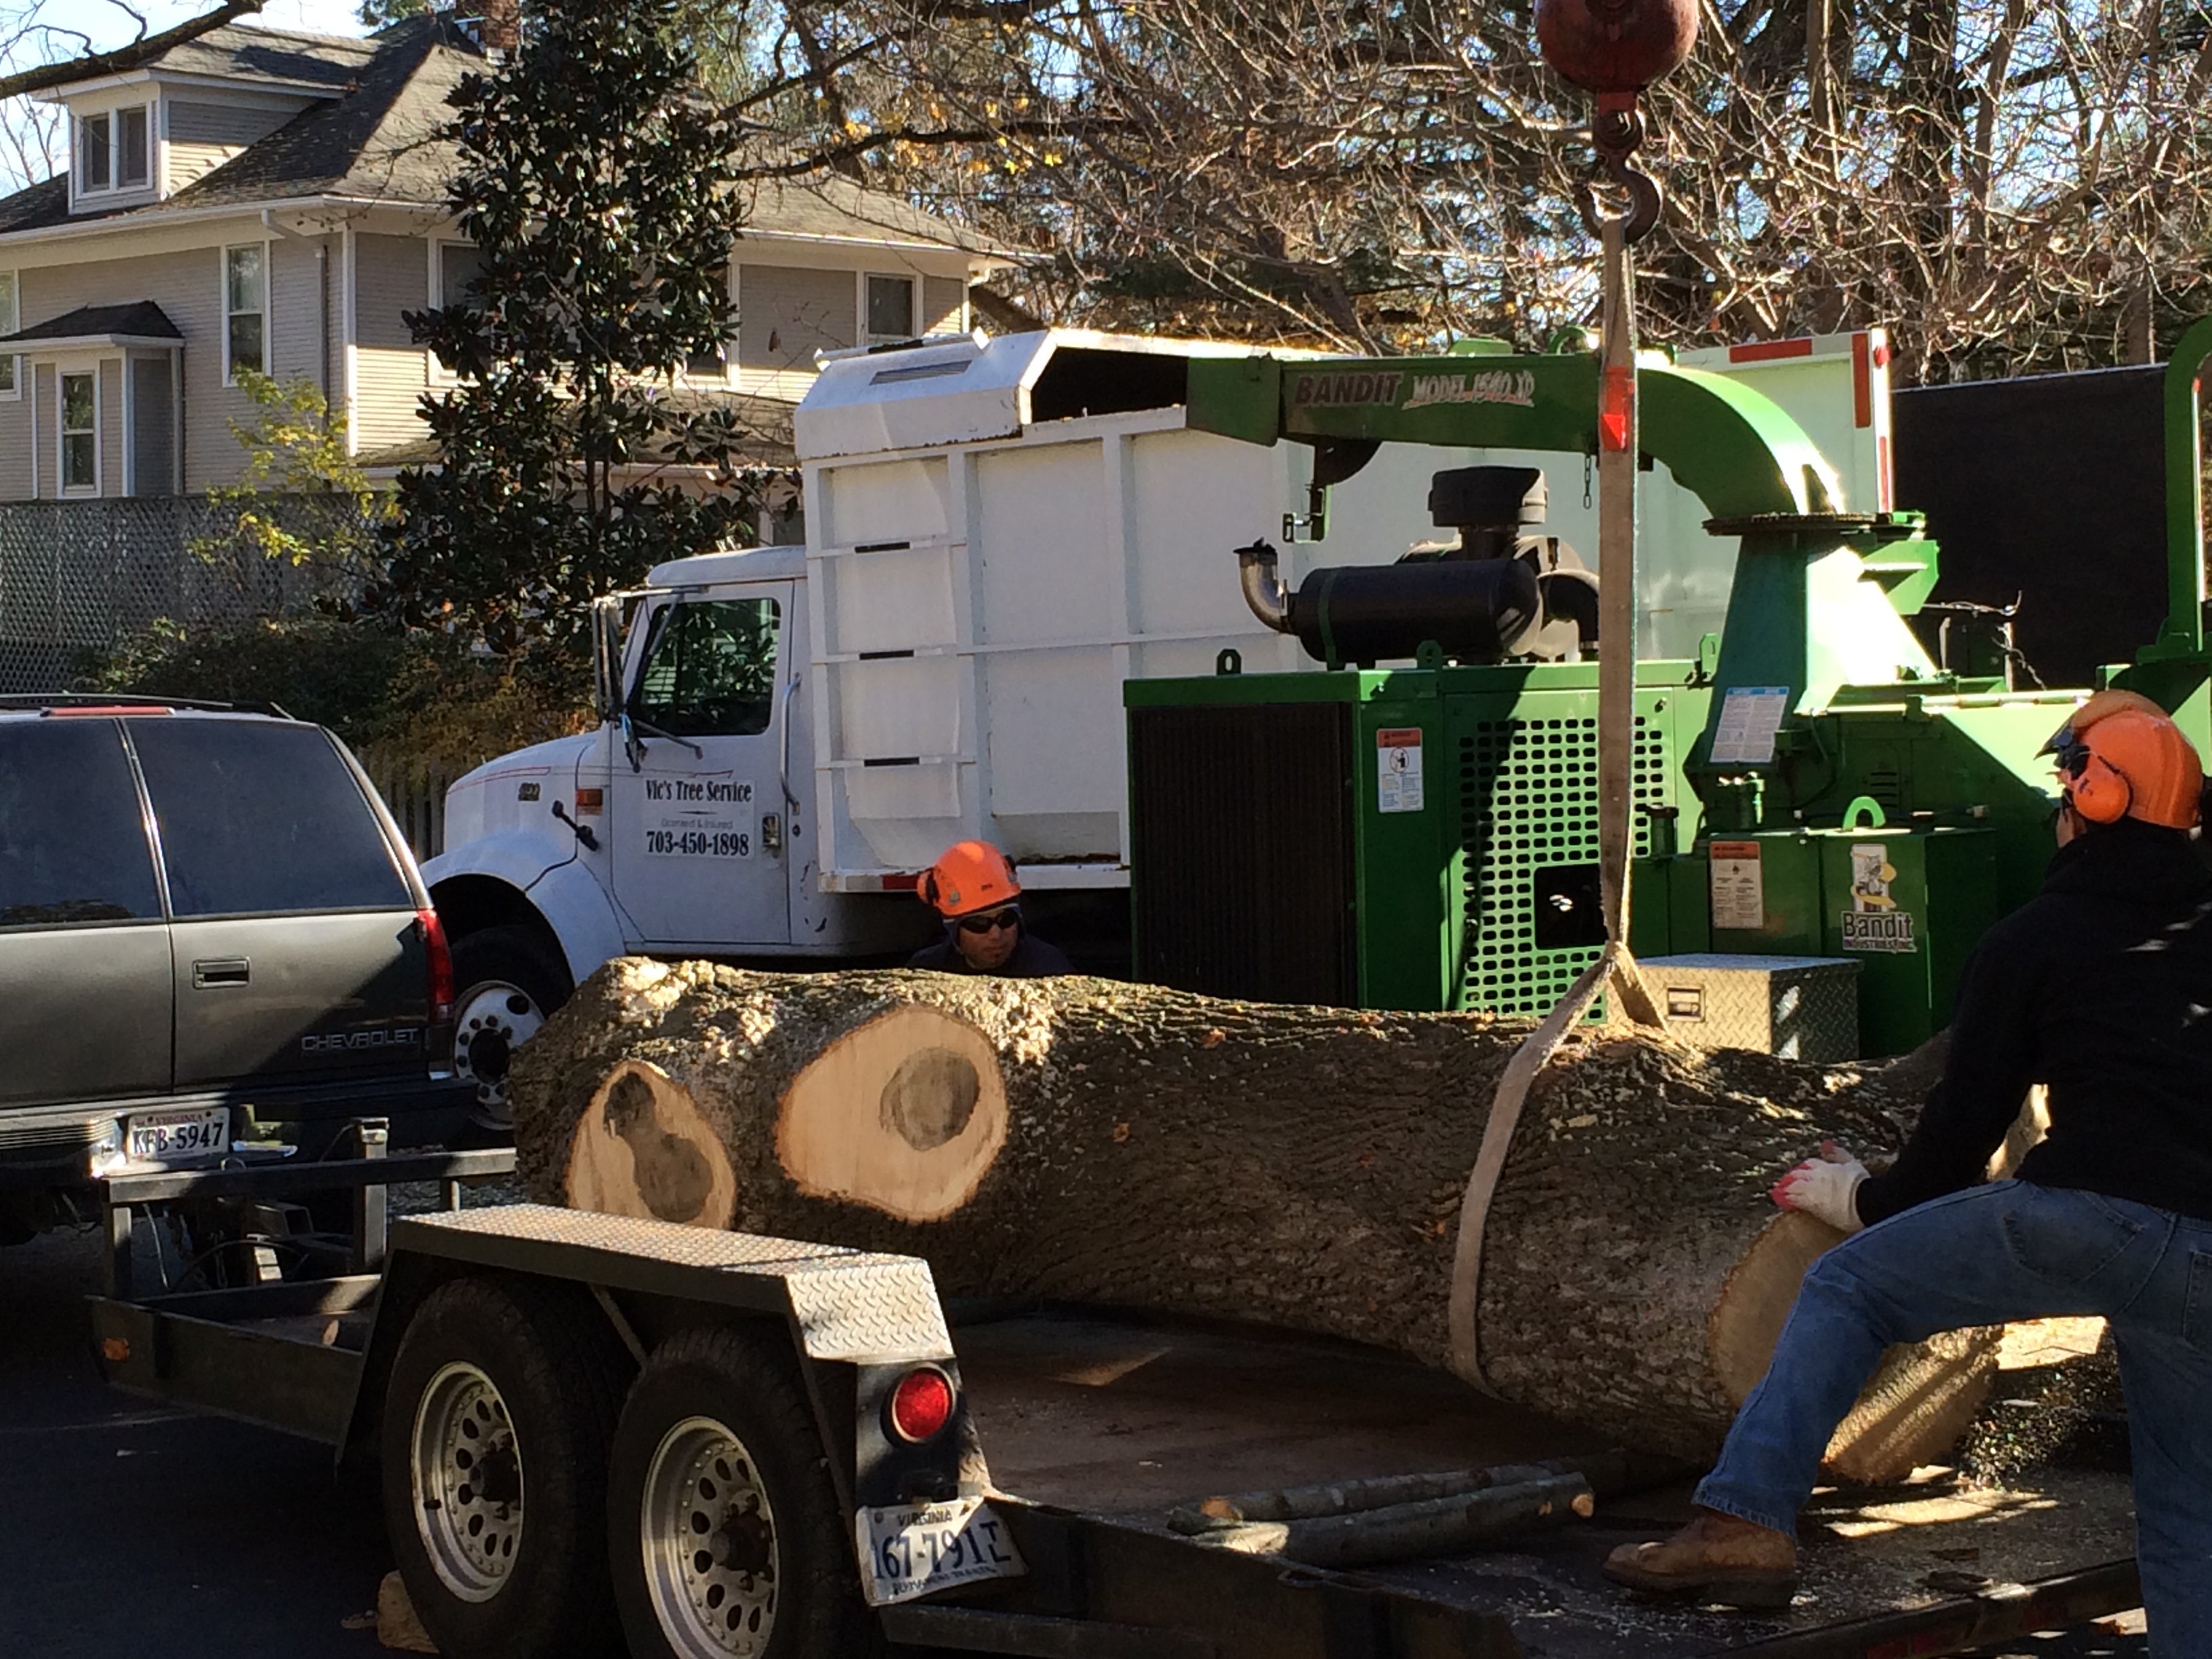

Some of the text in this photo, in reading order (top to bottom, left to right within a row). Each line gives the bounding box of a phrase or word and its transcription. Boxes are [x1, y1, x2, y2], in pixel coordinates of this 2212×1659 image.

[1295, 371, 1402, 405] BANDIT
[1412, 374, 1467, 402] MODEL
[647, 780, 752, 802] Vic's Tree Service
[647, 831, 750, 856] 703-450-1898
[1843, 913, 1911, 939] Bandit
[301, 1028, 419, 1050] CHEVROLET
[133, 1122, 224, 1153] KFB-5947
[897, 1510, 953, 1525] VIRGINIA
